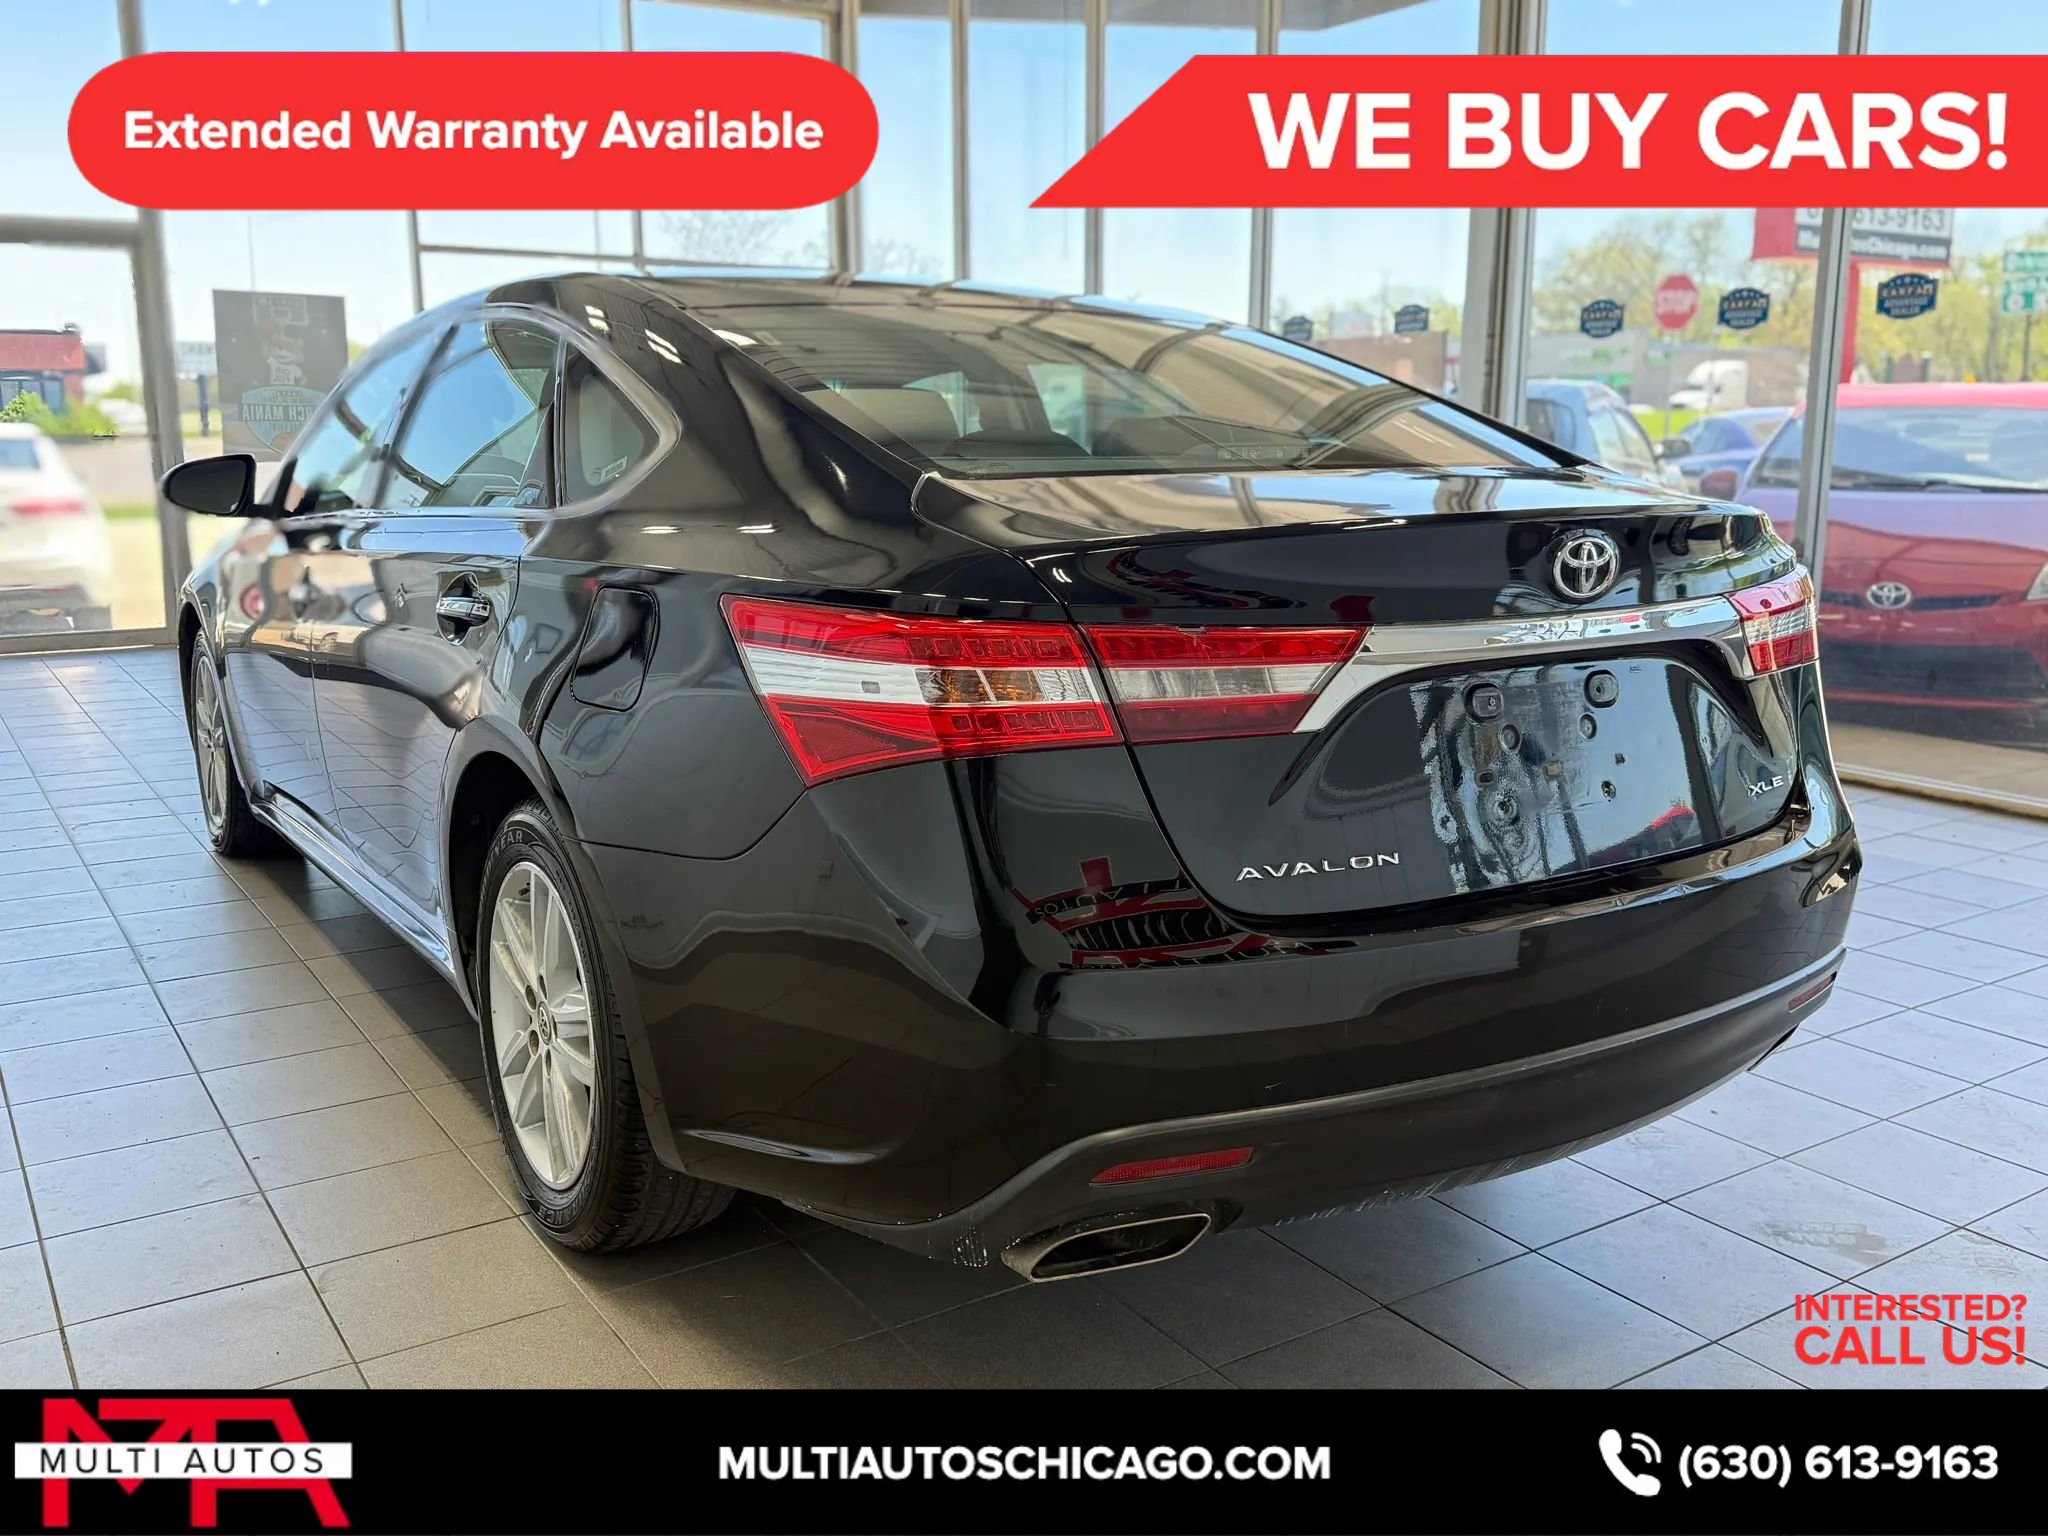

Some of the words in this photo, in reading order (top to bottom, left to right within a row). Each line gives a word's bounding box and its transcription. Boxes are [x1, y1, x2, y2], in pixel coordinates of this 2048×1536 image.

[1657, 288, 1698, 313] STOP
[1882, 285, 1934, 297] CARFAX
[1748, 775, 1785, 797] XLE
[1236, 852, 1401, 882] AVALON
